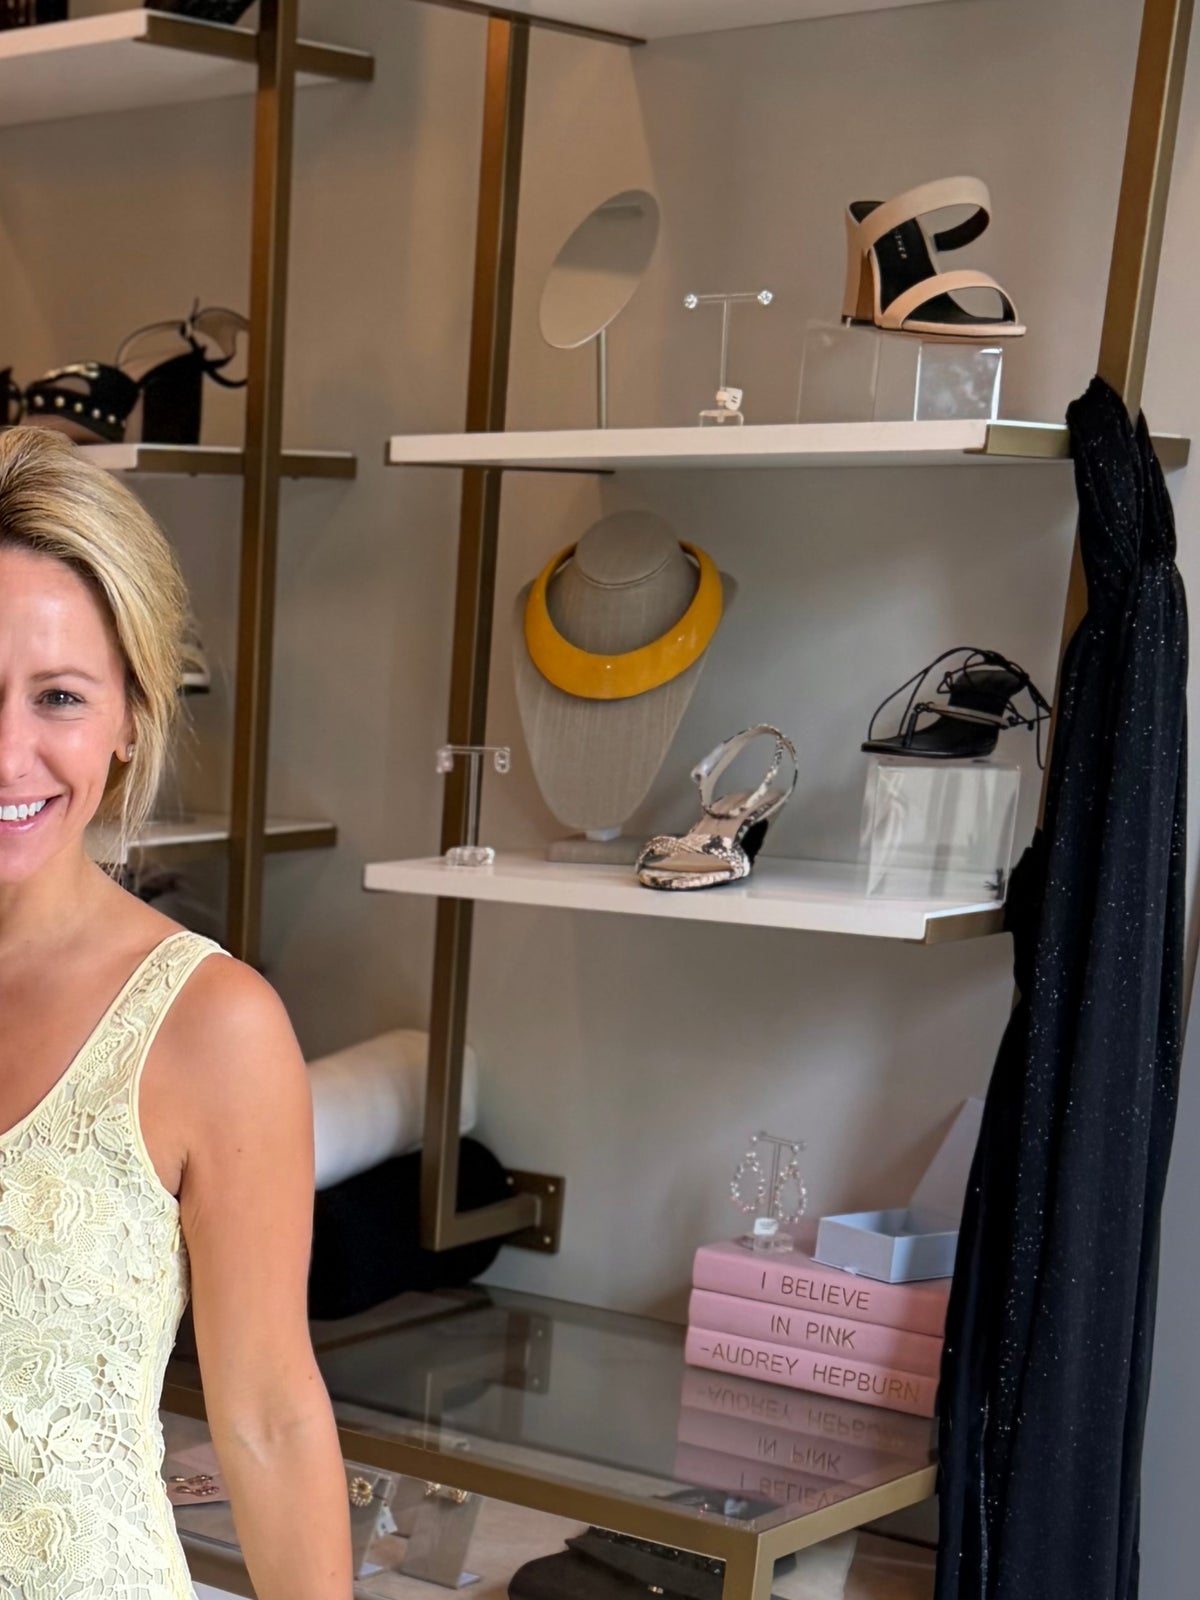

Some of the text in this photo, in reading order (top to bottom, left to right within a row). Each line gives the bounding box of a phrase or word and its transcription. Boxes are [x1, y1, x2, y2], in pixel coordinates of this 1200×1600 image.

[761, 1271, 871, 1311] I BELIEVE
[770, 1314, 857, 1350] IN PINK
[701, 1343, 921, 1402] -AUDREY HEPBURN
